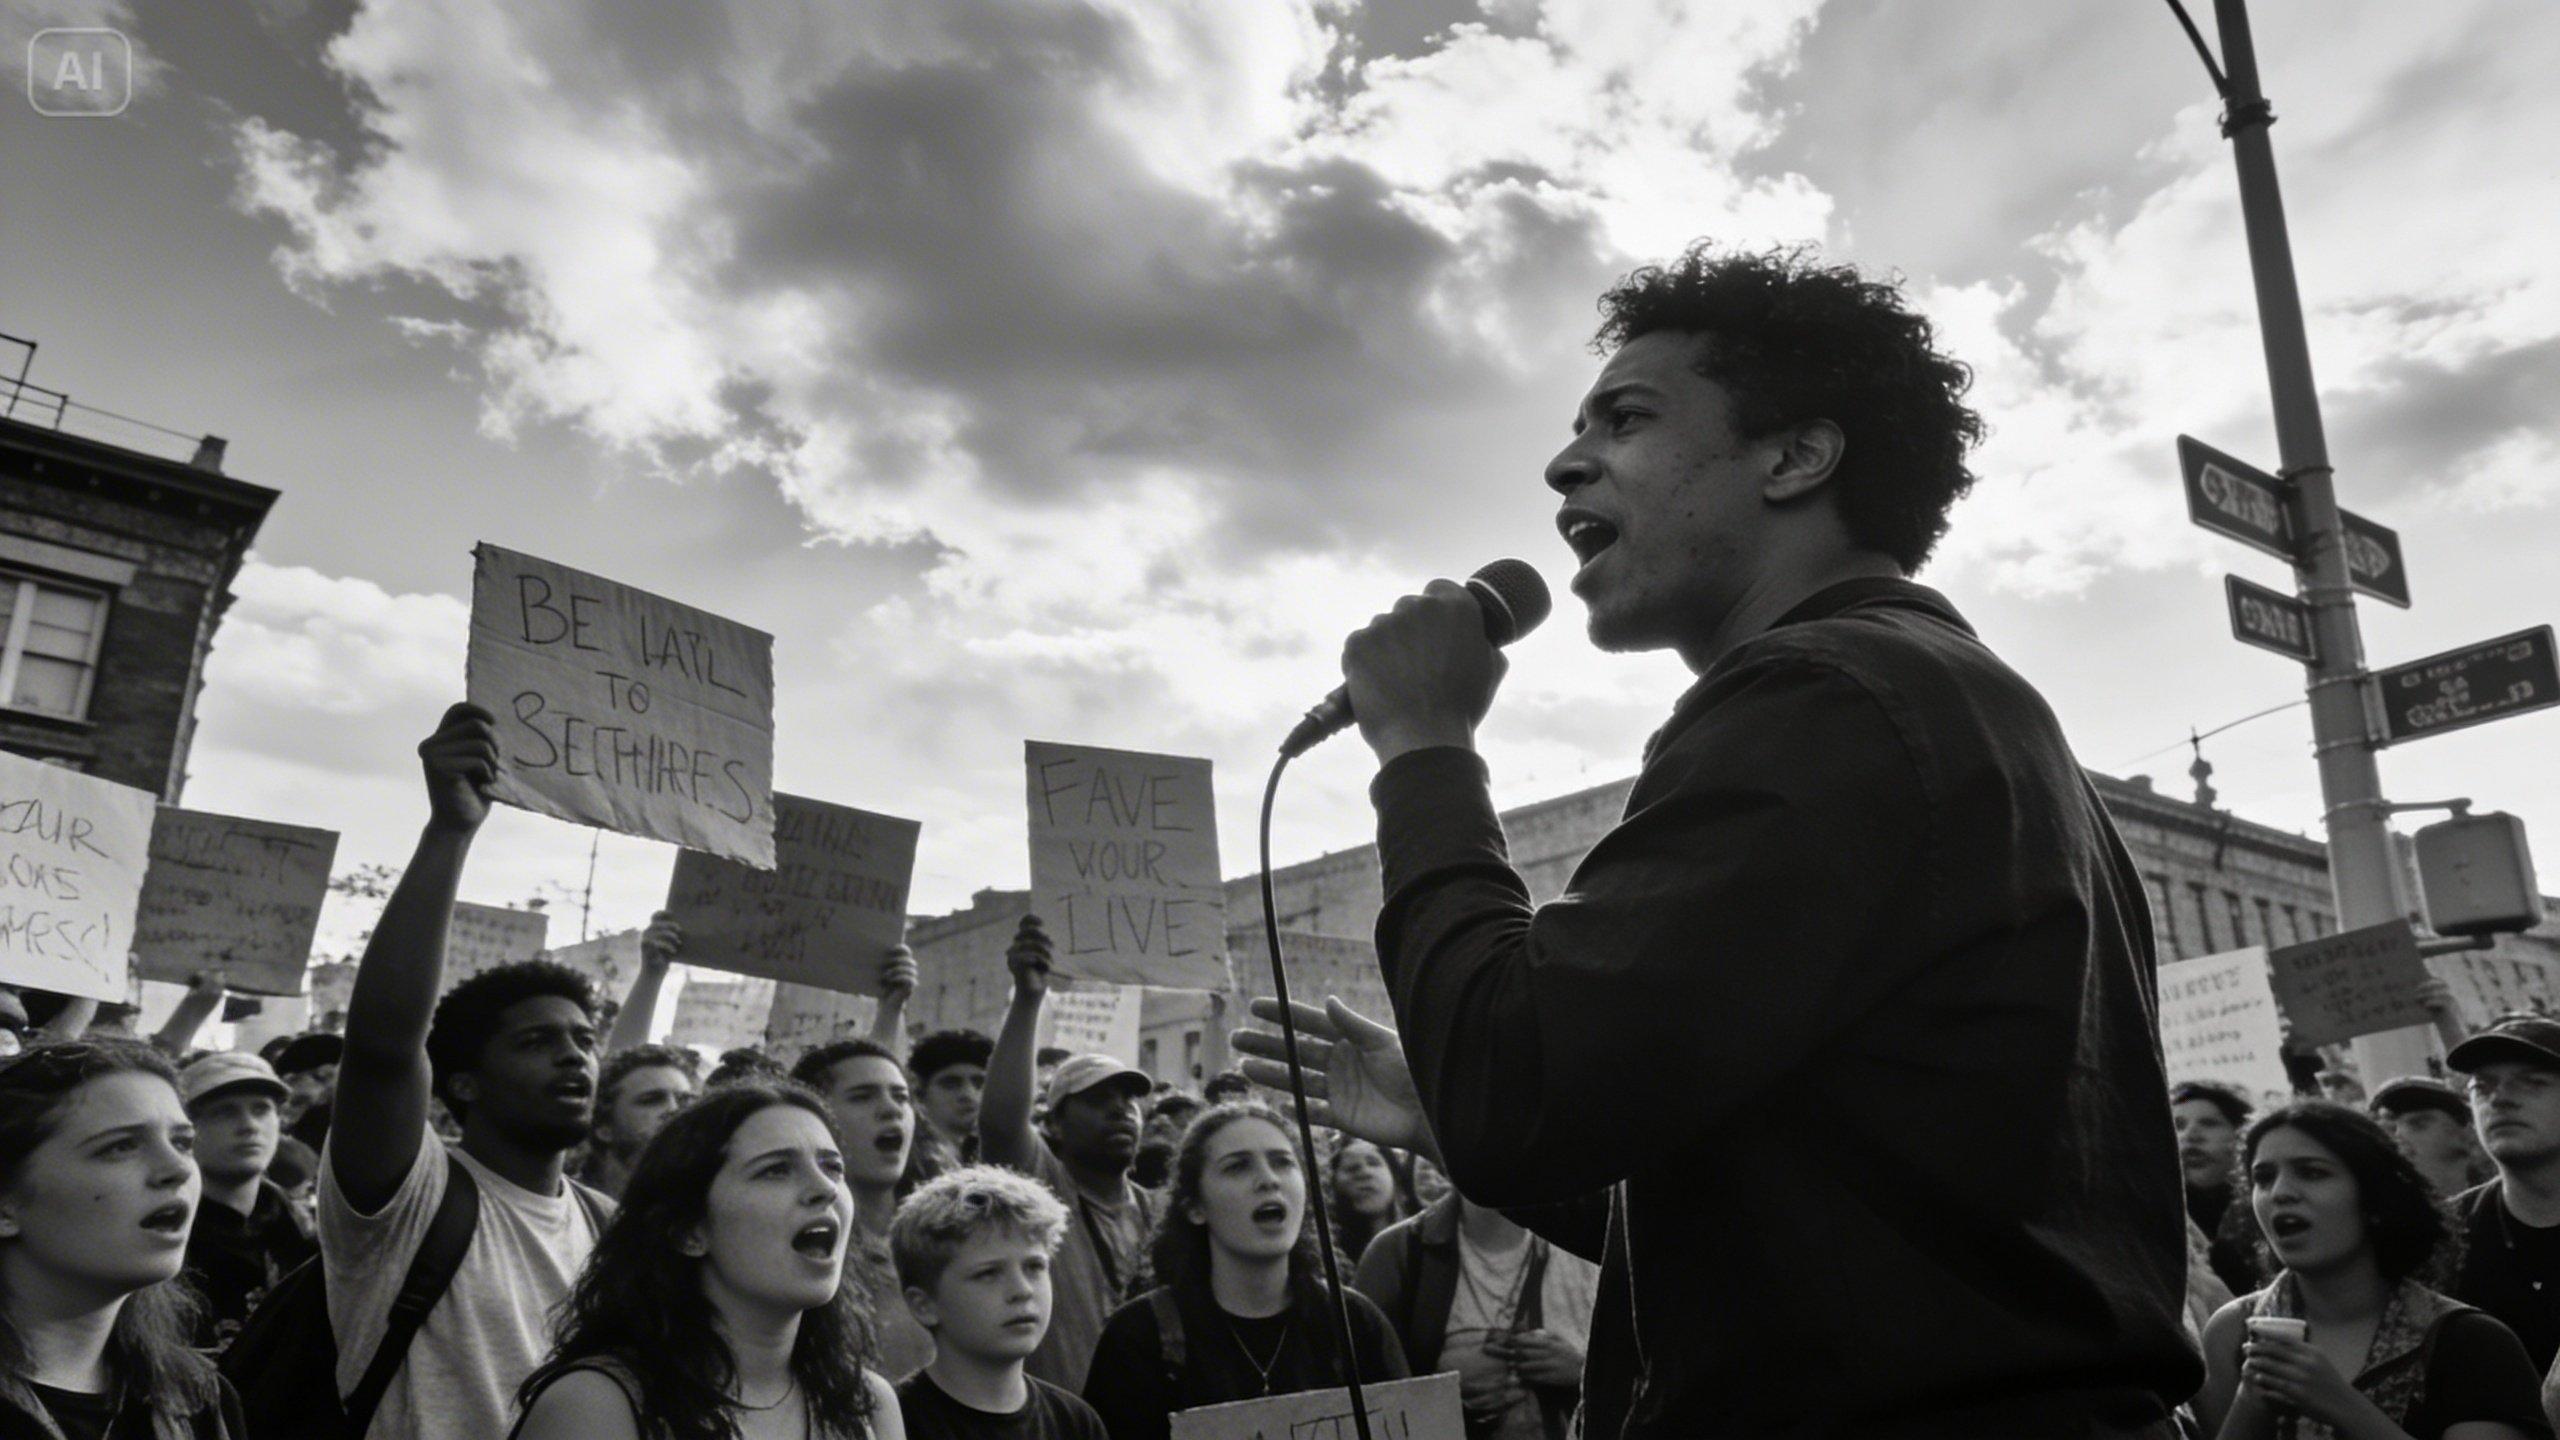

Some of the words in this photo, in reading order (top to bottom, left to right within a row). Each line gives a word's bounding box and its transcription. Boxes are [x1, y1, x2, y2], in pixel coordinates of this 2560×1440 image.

[515, 573, 602, 652] BE
[595, 670, 650, 715] TO
[1041, 757, 1195, 833] FAVE
[1057, 894, 1197, 958] LIVE
